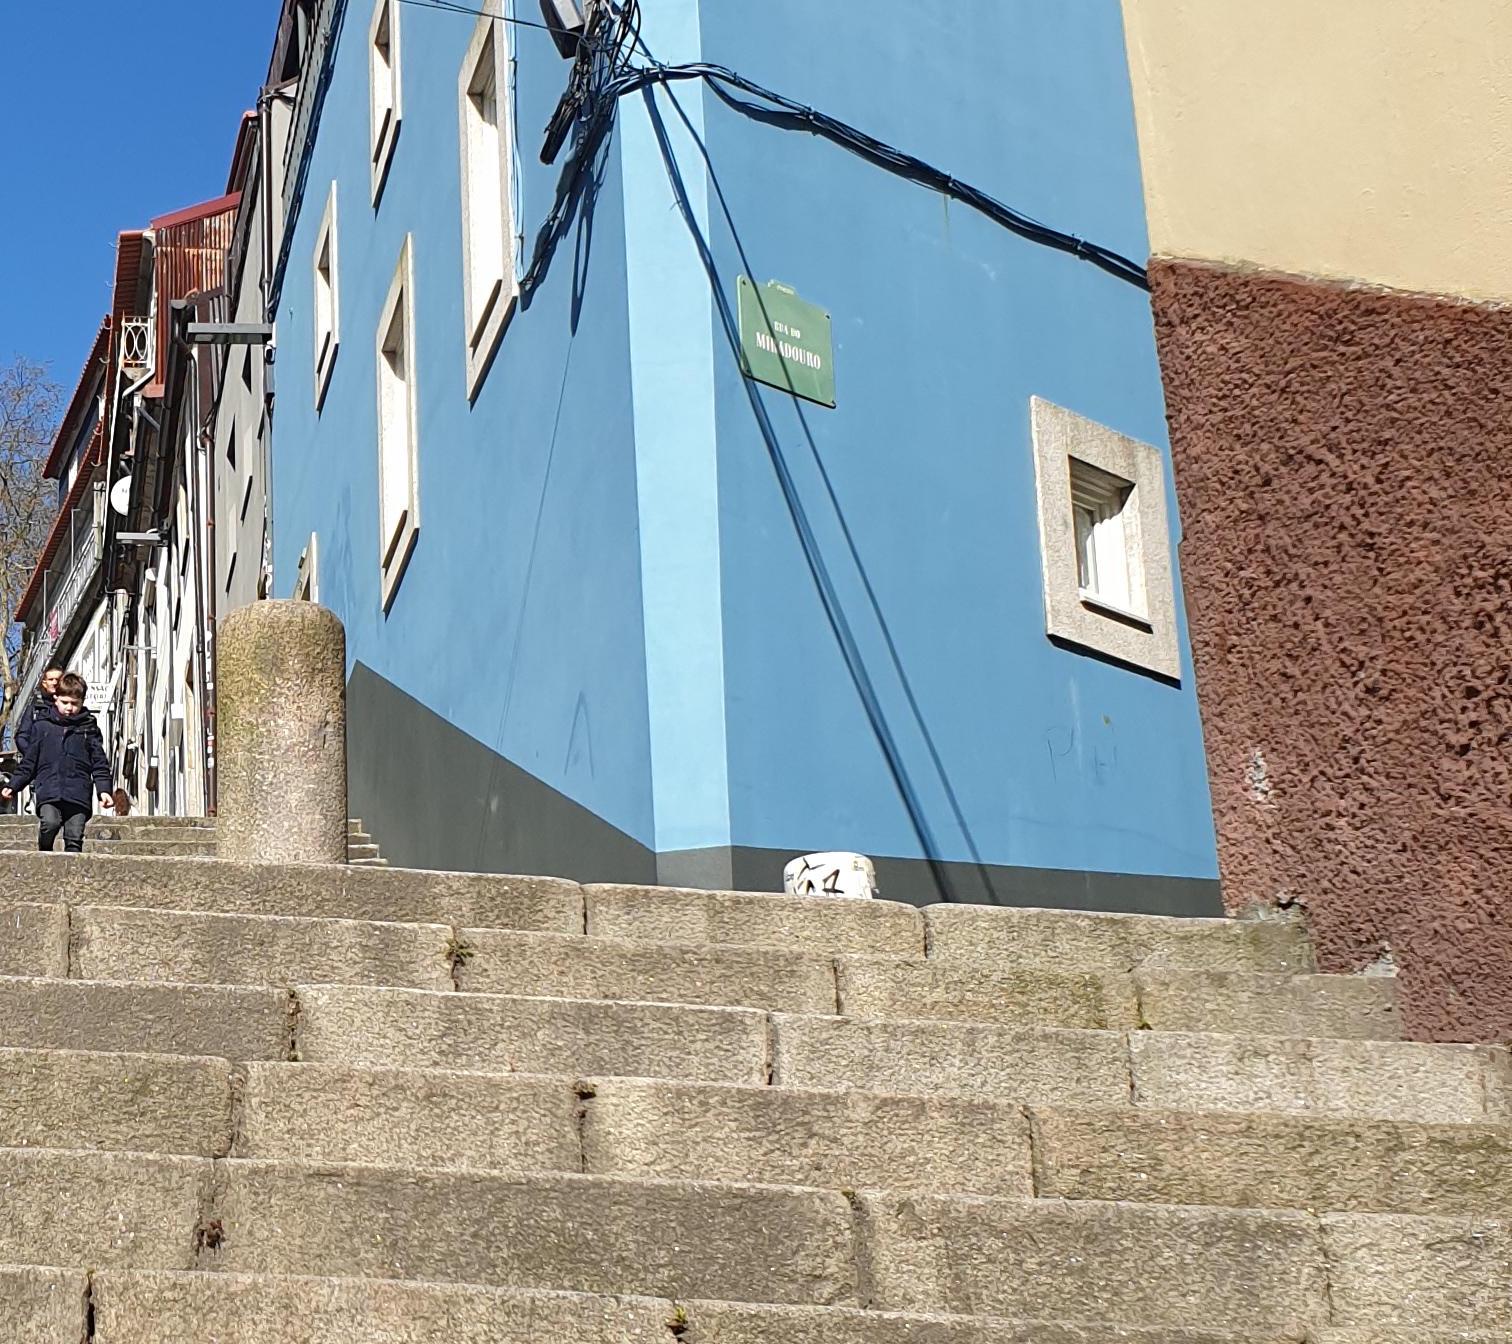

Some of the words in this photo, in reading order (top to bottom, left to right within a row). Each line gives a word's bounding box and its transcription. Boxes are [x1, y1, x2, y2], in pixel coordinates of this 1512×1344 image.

[774, 321, 789, 336] RUA
[790, 327, 801, 340] DO
[755, 331, 822, 370] MIRADOURO
